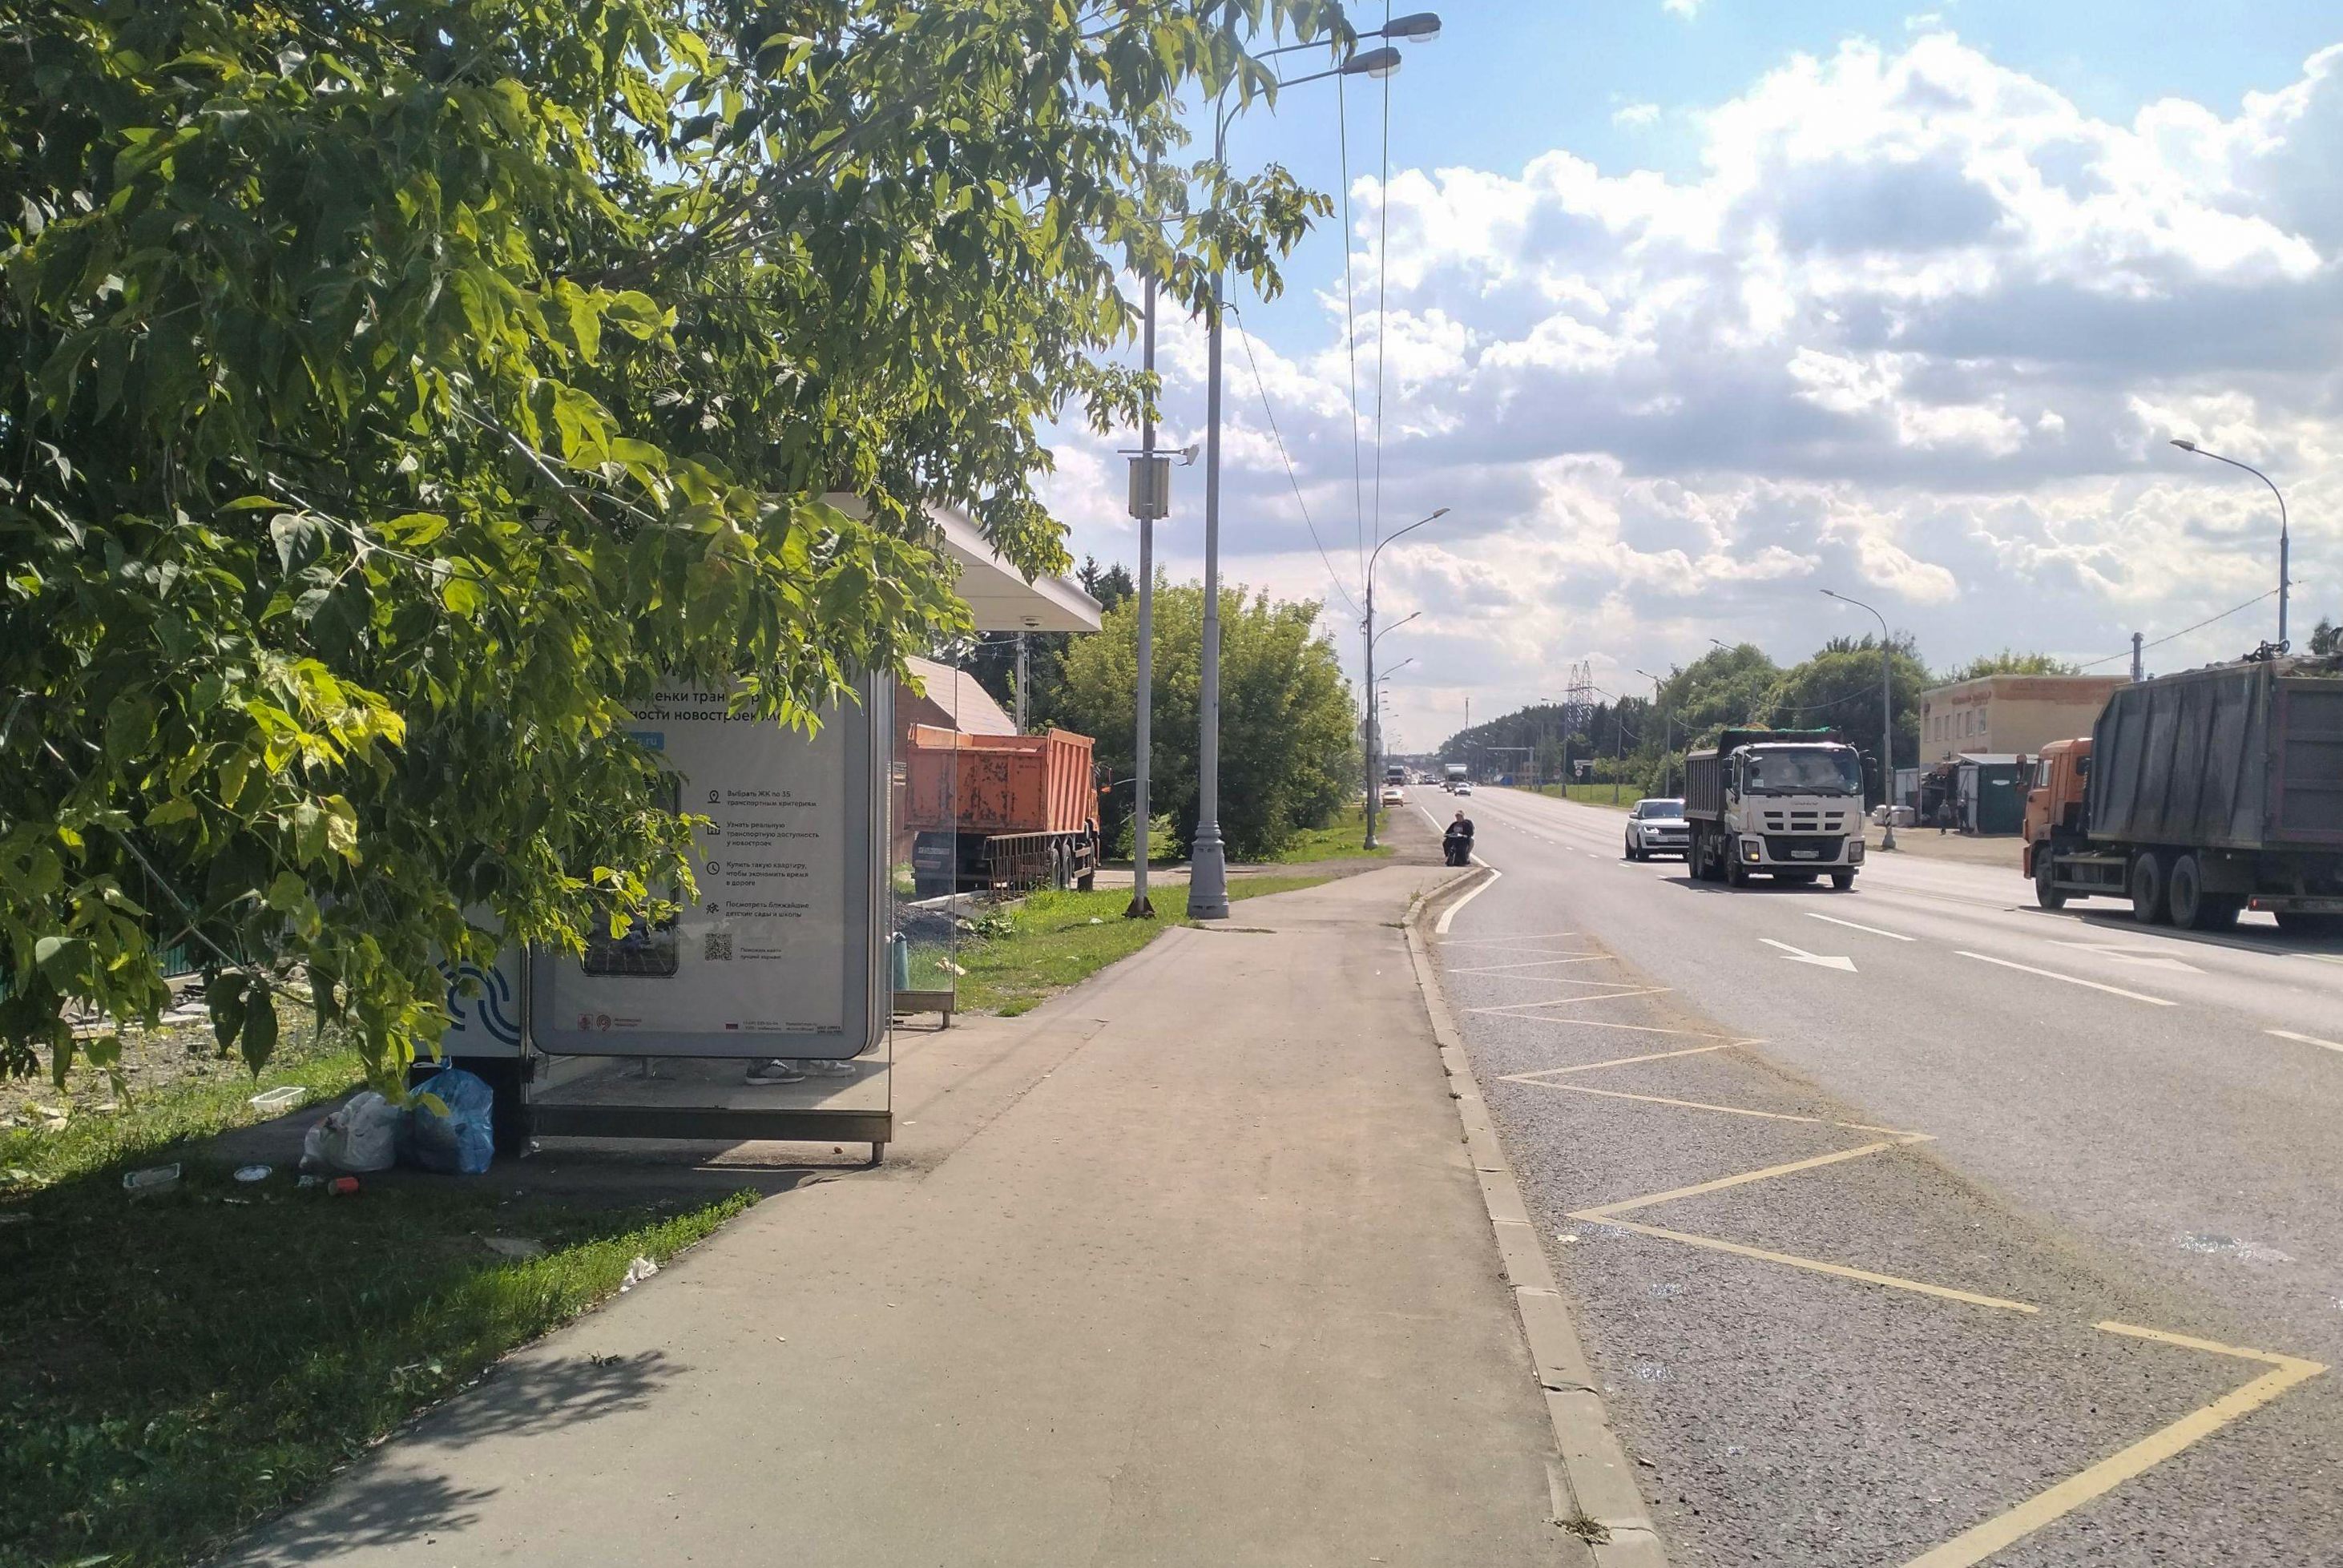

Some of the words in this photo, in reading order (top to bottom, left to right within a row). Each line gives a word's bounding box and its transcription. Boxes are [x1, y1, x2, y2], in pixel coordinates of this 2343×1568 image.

[728, 790, 756, 798] Выбрать
[726, 861, 750, 869] Купить
[726, 901, 767, 909] Посмотреть
